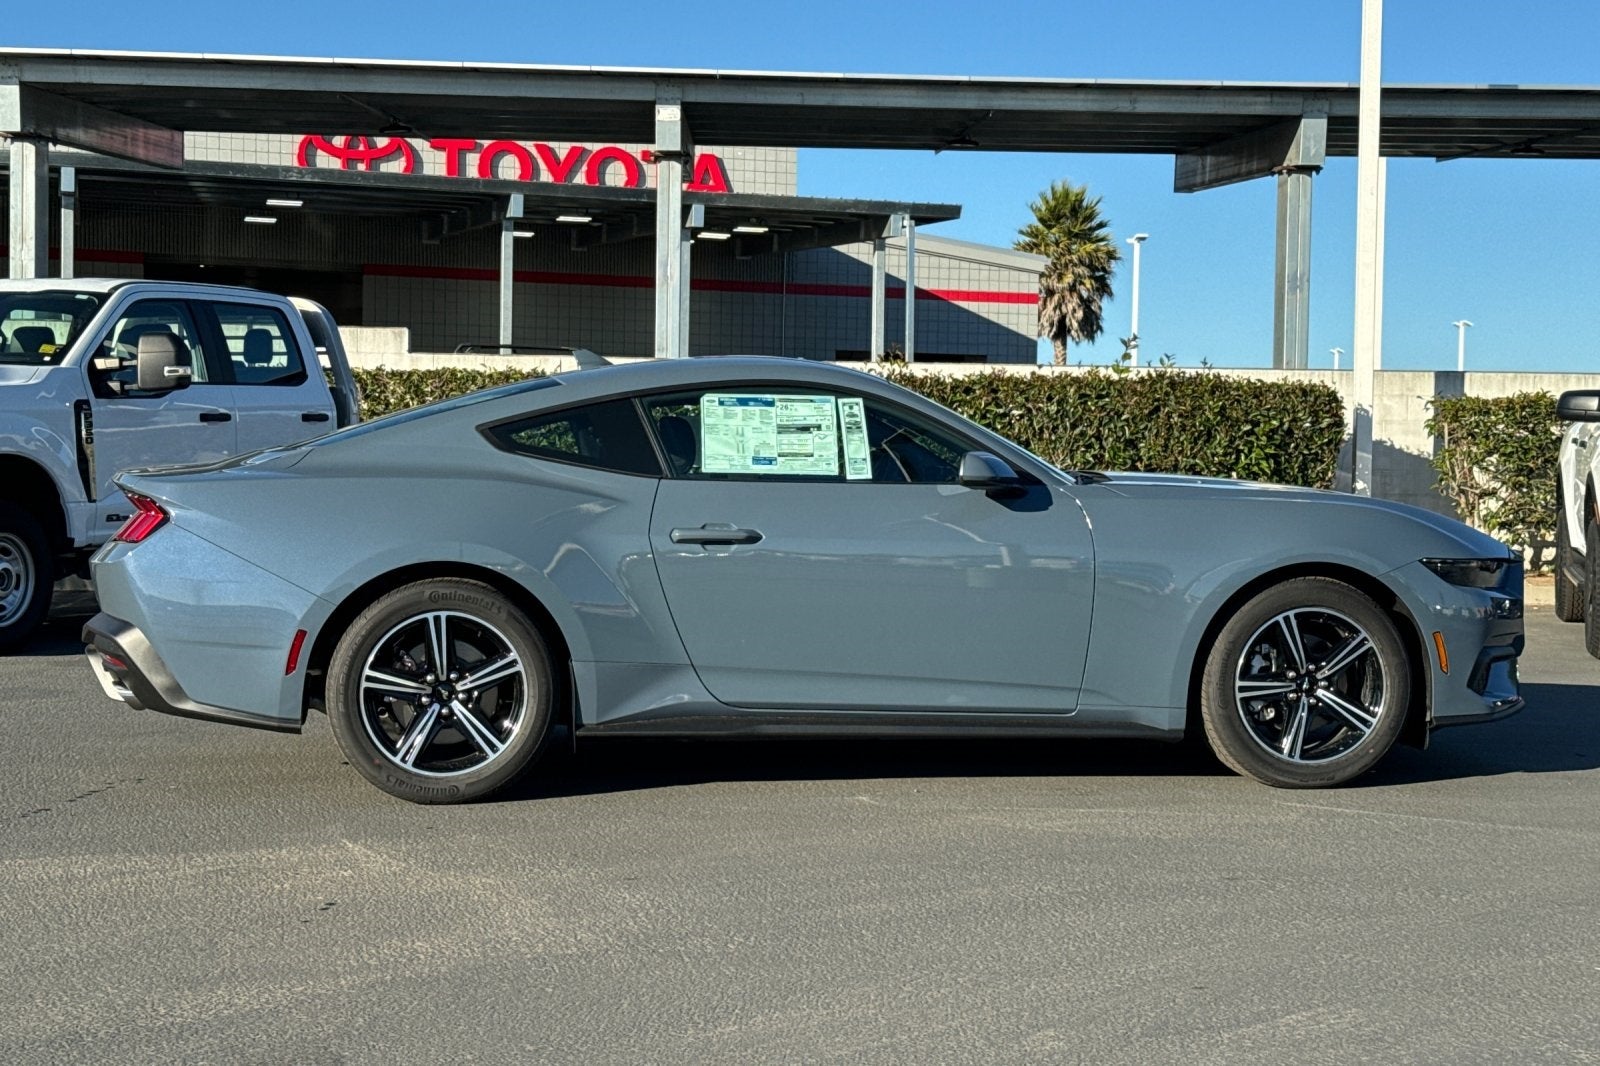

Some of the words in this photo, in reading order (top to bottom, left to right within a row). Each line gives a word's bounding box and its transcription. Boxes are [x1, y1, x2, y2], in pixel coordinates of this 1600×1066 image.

[430, 139, 728, 192] TOYOA
[428, 590, 494, 611] Continental
[392, 778, 460, 797] Continental
